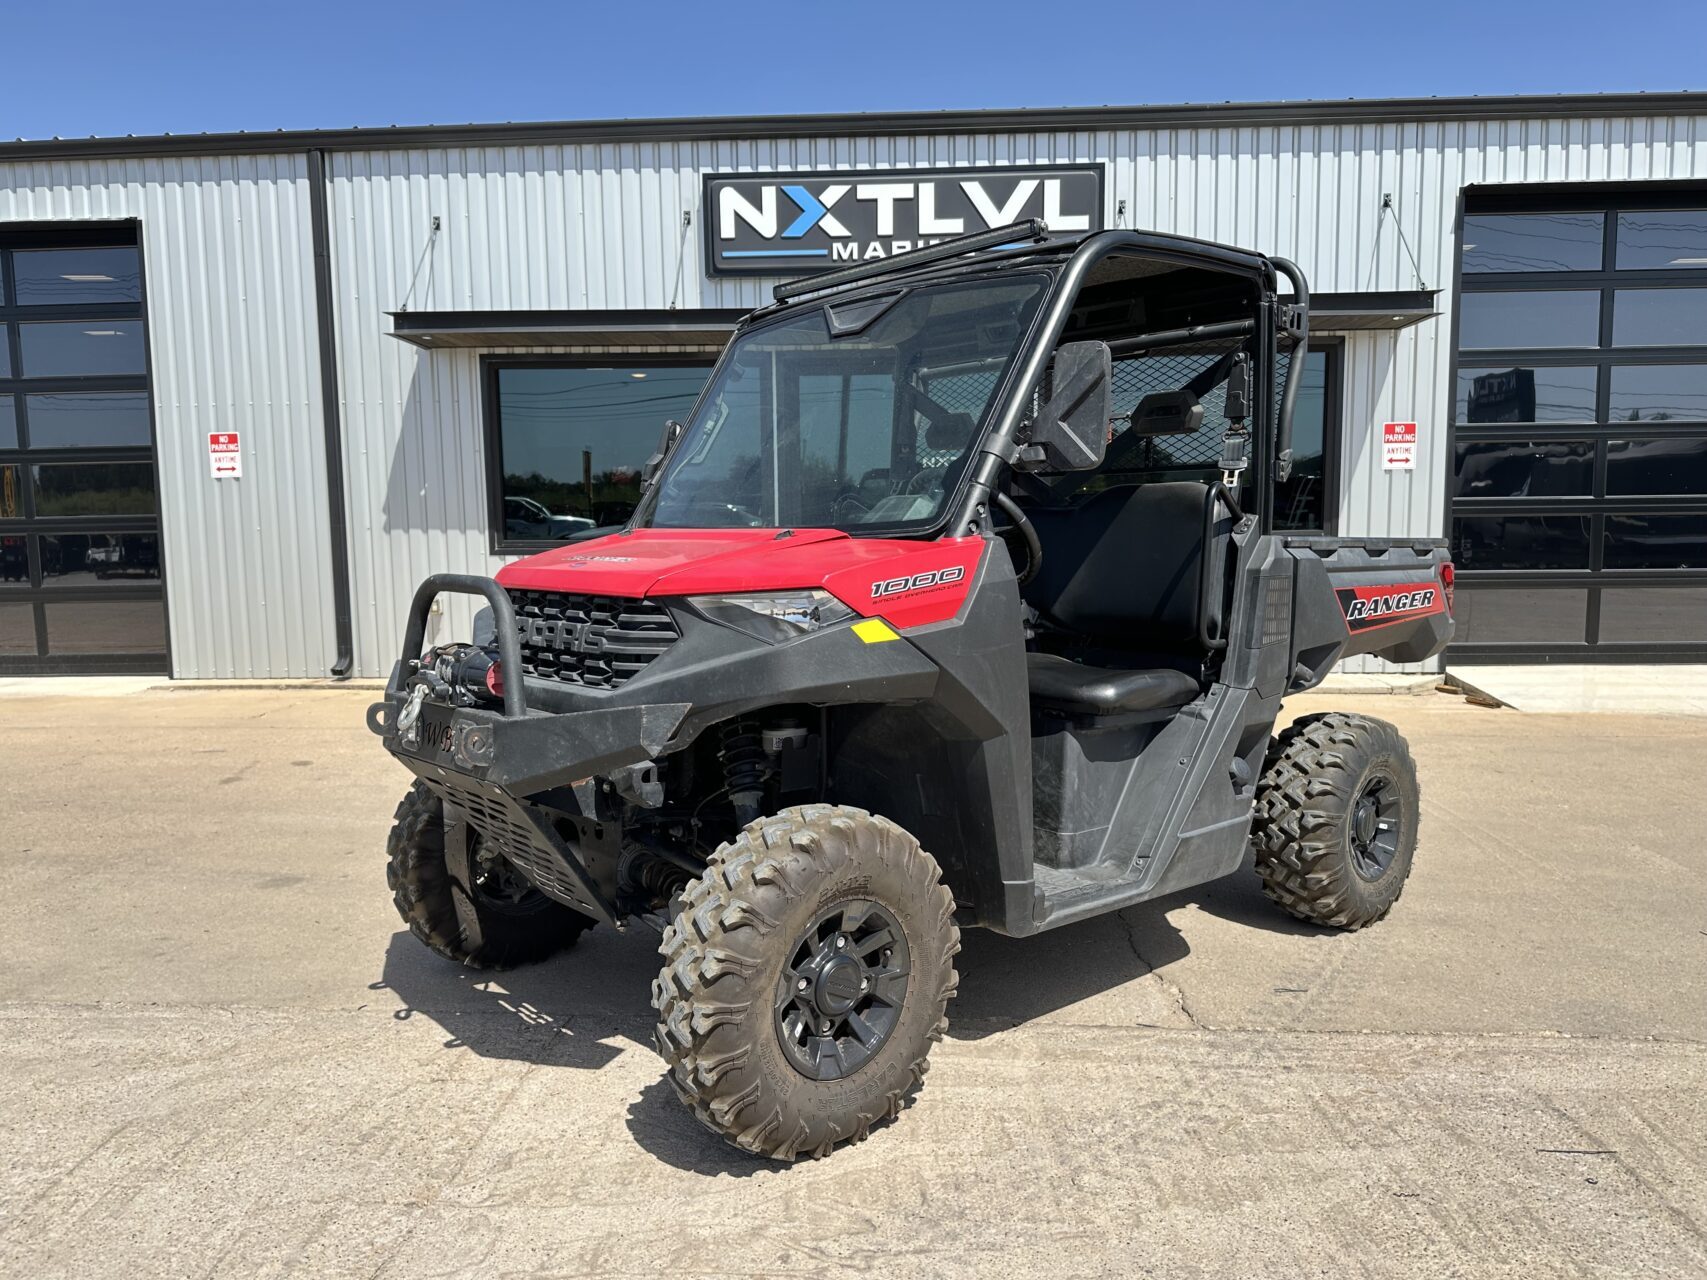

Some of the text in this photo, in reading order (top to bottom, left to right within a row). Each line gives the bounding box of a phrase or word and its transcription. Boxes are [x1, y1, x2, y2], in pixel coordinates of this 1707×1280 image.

[719, 179, 1090, 239] NXTLVL
[1394, 425, 1405, 433] NO
[218, 435, 228, 443] NO
[1384, 434, 1415, 442] PARKING
[210, 443, 239, 451] PARKING
[1386, 447, 1412, 455] ANYTIME
[871, 565, 965, 598] 1000
[1346, 589, 1435, 620] RANGER
